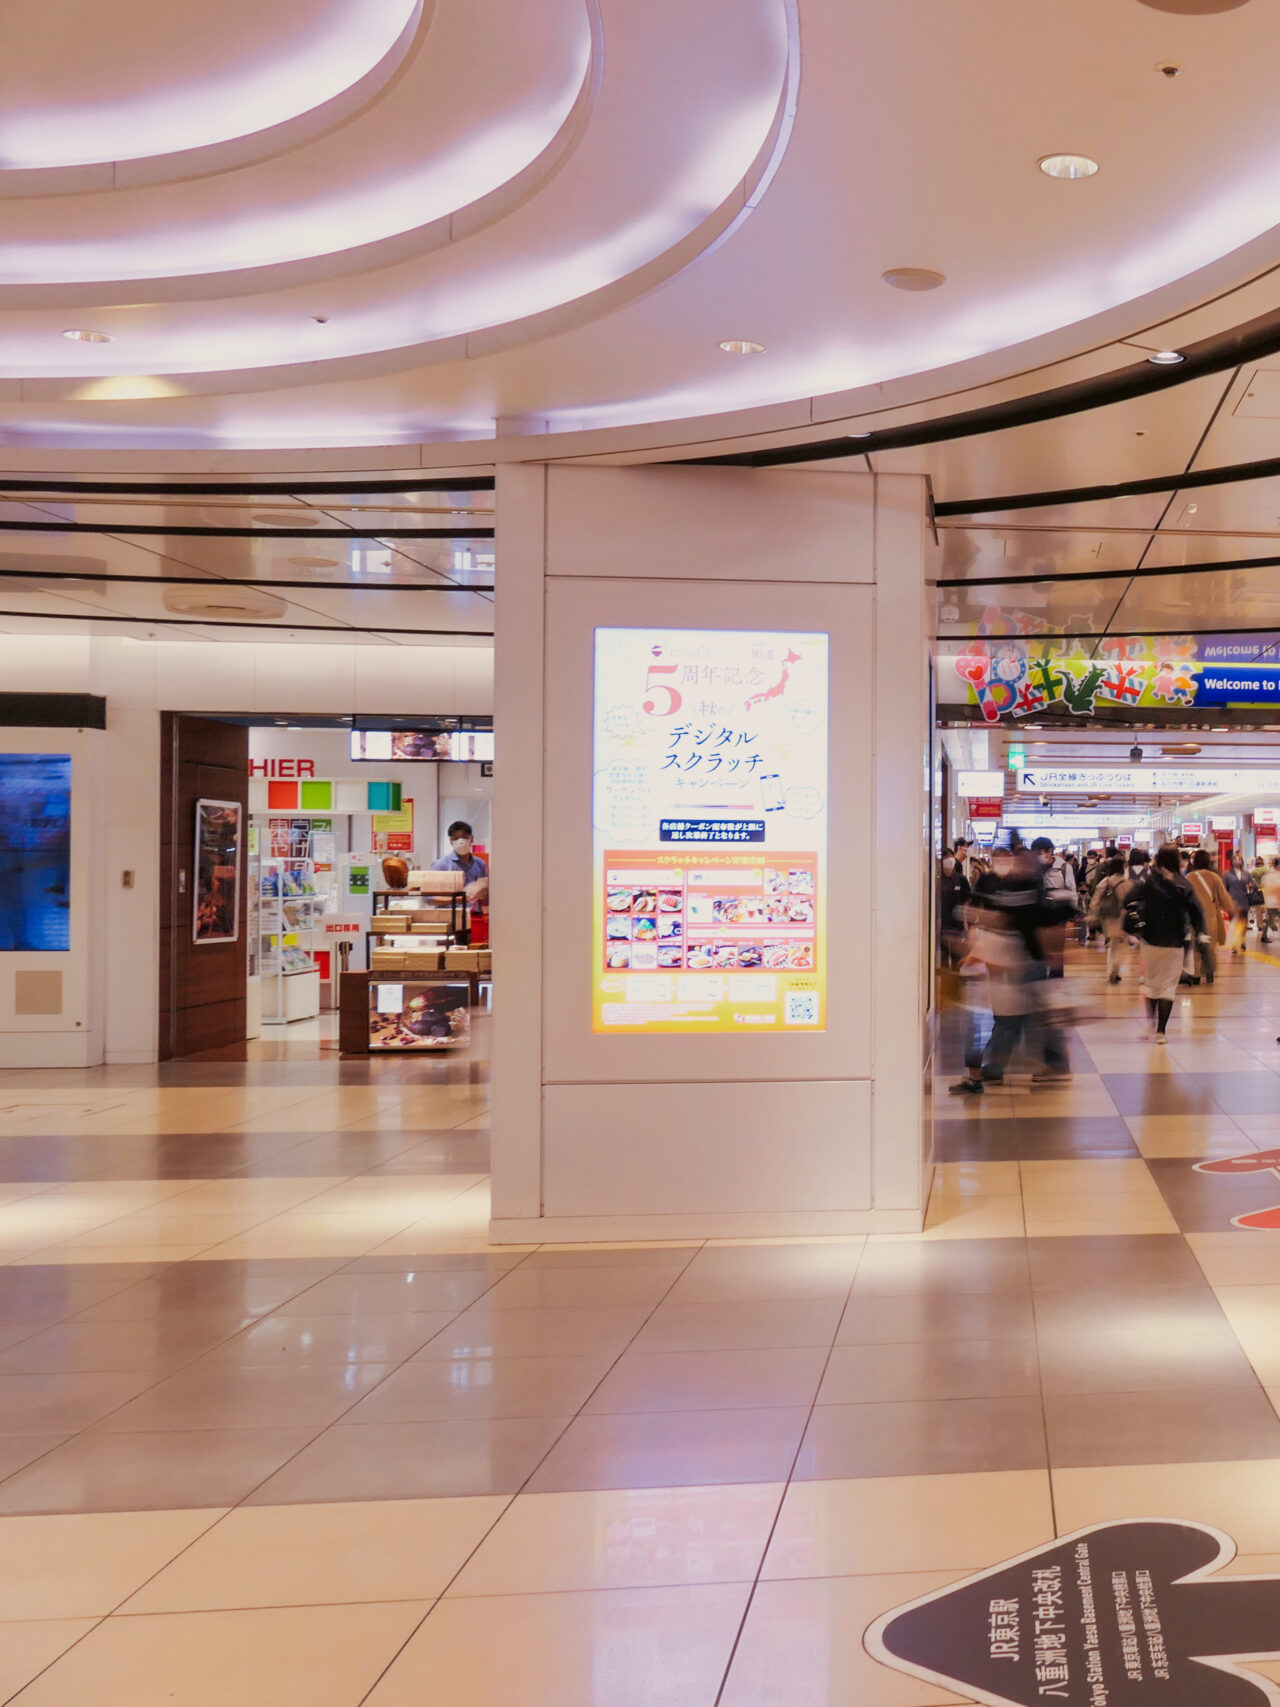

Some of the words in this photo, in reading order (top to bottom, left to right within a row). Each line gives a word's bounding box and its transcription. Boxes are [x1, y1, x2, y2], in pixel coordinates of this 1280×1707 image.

[1204, 678, 1260, 690] Welcome
[1262, 680, 1276, 690] to
[667, 722, 758, 749] デジタル
[659, 752, 764, 773] スクラッチ
[674, 777, 750, 789] キャンペーン
[1074, 1542, 1089, 1559] Gate
[1075, 1559, 1092, 1585] Central
[1078, 1586, 1097, 1624] Basement
[987, 1597, 1021, 1662] JR東京駅
[1031, 1565, 1070, 1698] 八重洲地下中央改札
[1082, 1624, 1100, 1650] Yaesu
[1084, 1650, 1105, 1682] Station
[1126, 1670, 1143, 1682] JR
[1153, 1668, 1170, 1680] JR
